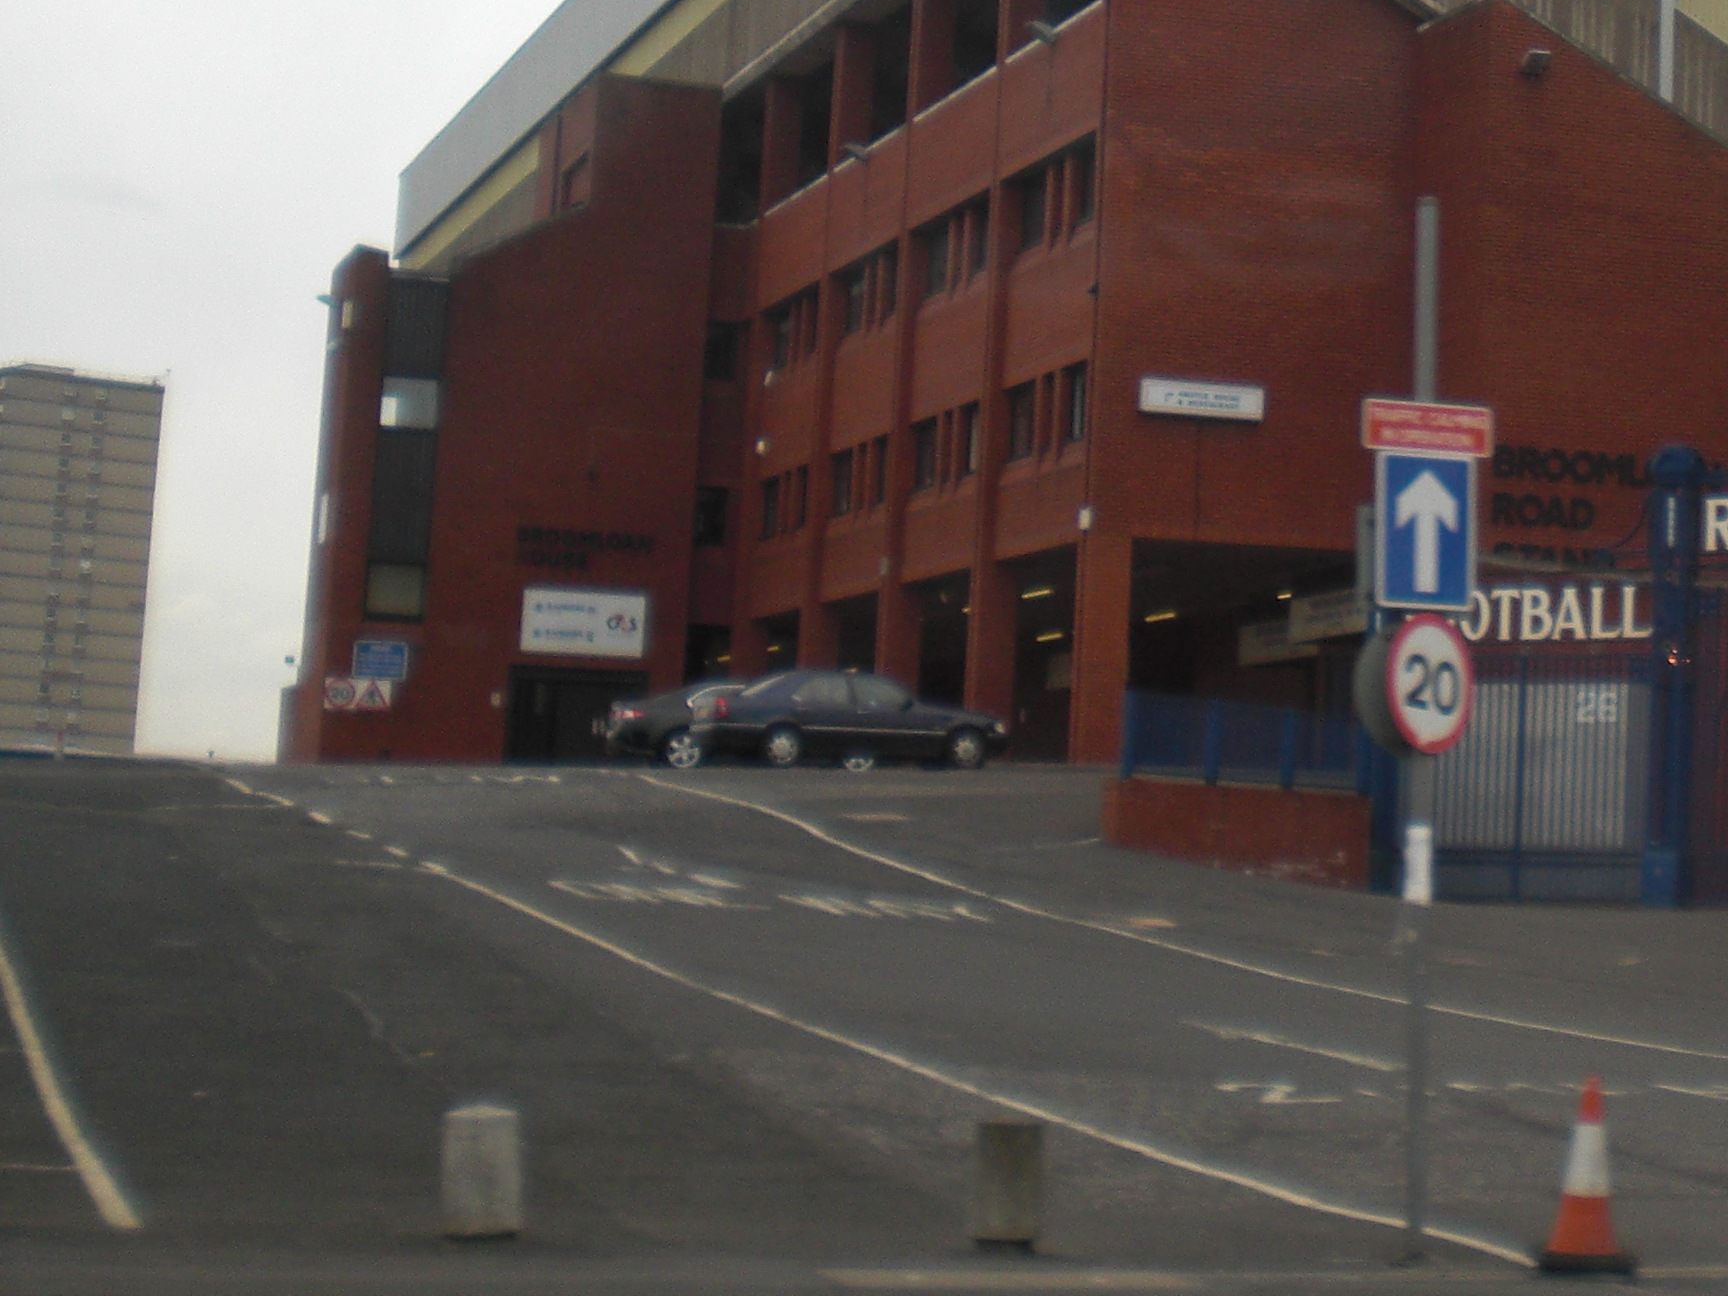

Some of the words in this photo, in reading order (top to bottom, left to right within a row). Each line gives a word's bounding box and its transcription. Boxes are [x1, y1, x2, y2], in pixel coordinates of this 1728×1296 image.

[1492, 492, 1596, 531] ROAD
[1459, 585, 1654, 642] OTBALL
[1404, 654, 1459, 716] 20
